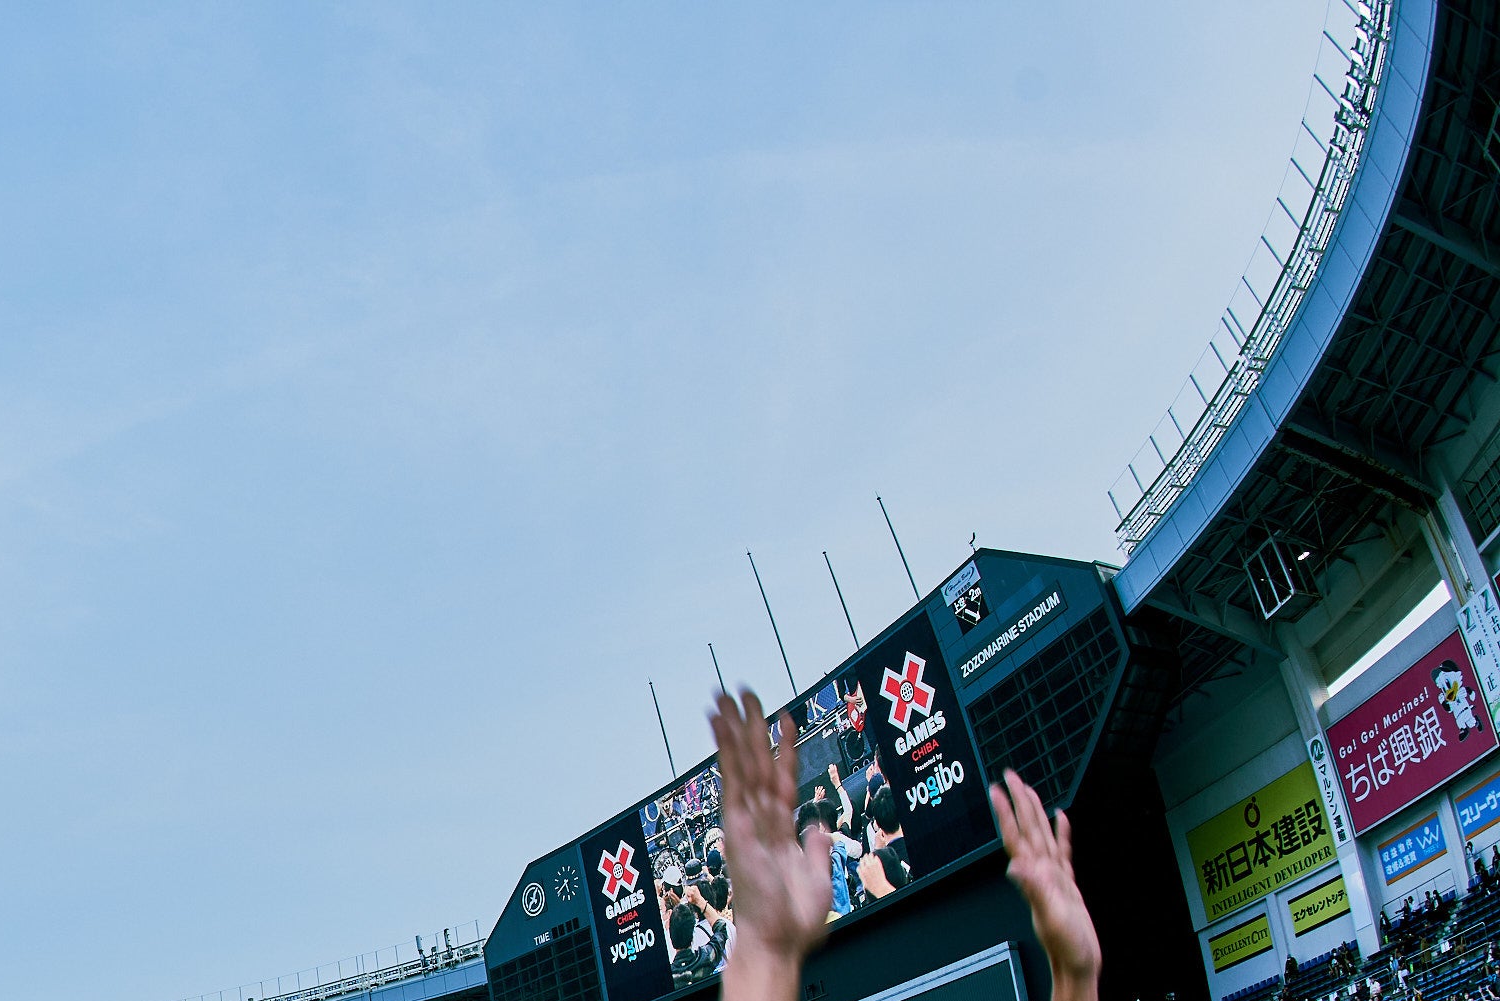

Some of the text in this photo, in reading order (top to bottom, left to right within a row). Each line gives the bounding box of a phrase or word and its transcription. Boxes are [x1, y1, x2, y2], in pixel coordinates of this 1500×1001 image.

[960, 591, 1060, 678] ZOZOMARINE STADIUM
[895, 711, 946, 755] GAMES
[1339, 686, 1429, 759] Go! Go! Marines!
[911, 739, 940, 761] CHIBA
[914, 752, 943, 773] Presented by
[1345, 706, 1447, 802] ちば興銀
[905, 761, 965, 811] yogibo
[1201, 798, 1327, 897] 新日本建設
[1211, 845, 1332, 916] INTELLIGENT DEVELOPER
[606, 889, 645, 920] GAMES
[617, 910, 638, 926] CHIBA
[1293, 891, 1348, 923] エクセレントシテ
[533, 931, 550, 946] TIME
[618, 923, 634, 934] Presented
[610, 929, 655, 963] yogibo
